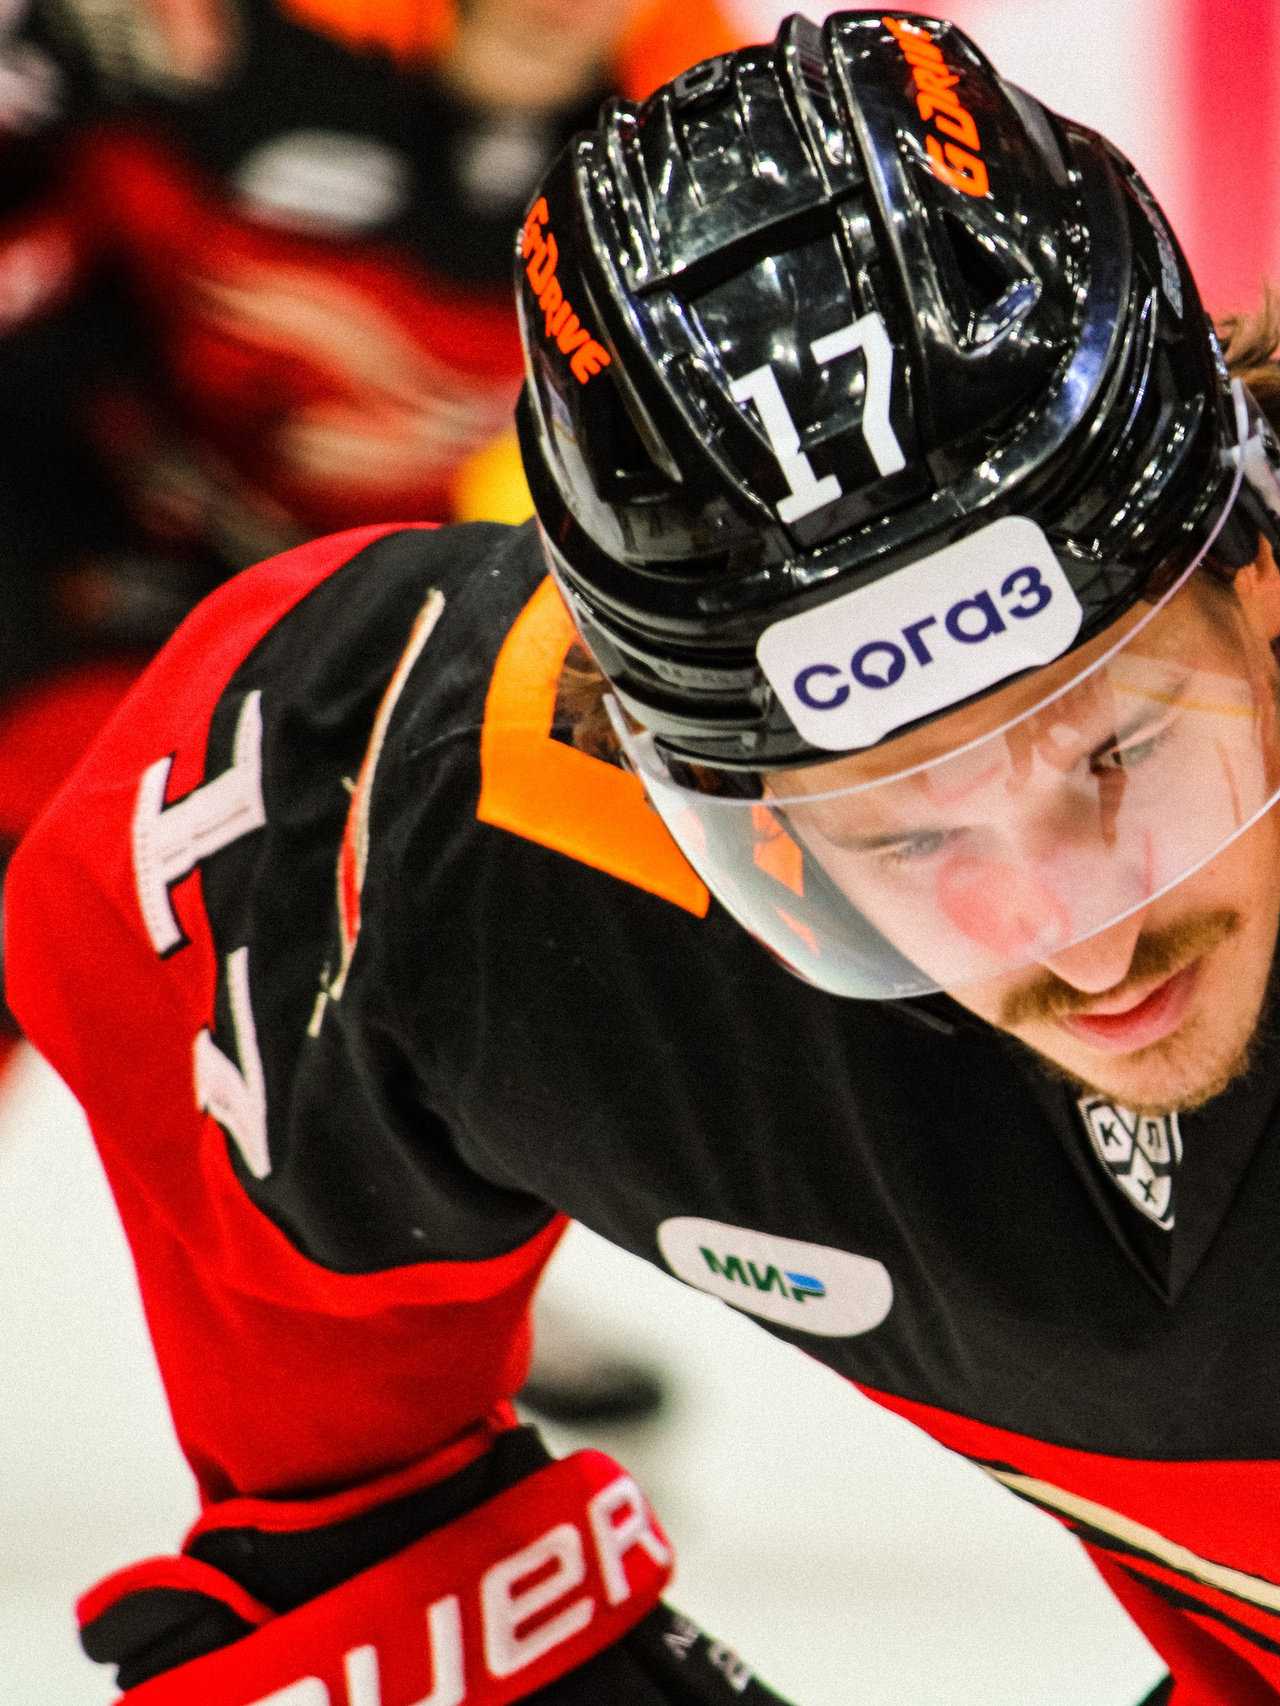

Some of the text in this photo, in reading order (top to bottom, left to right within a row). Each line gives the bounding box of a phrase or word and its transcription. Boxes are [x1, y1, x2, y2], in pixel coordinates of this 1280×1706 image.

[728, 312, 906, 524] 17
[793, 565, 1053, 711] согаз
[130, 689, 272, 1180] 17
[698, 1246, 827, 1303] МИР
